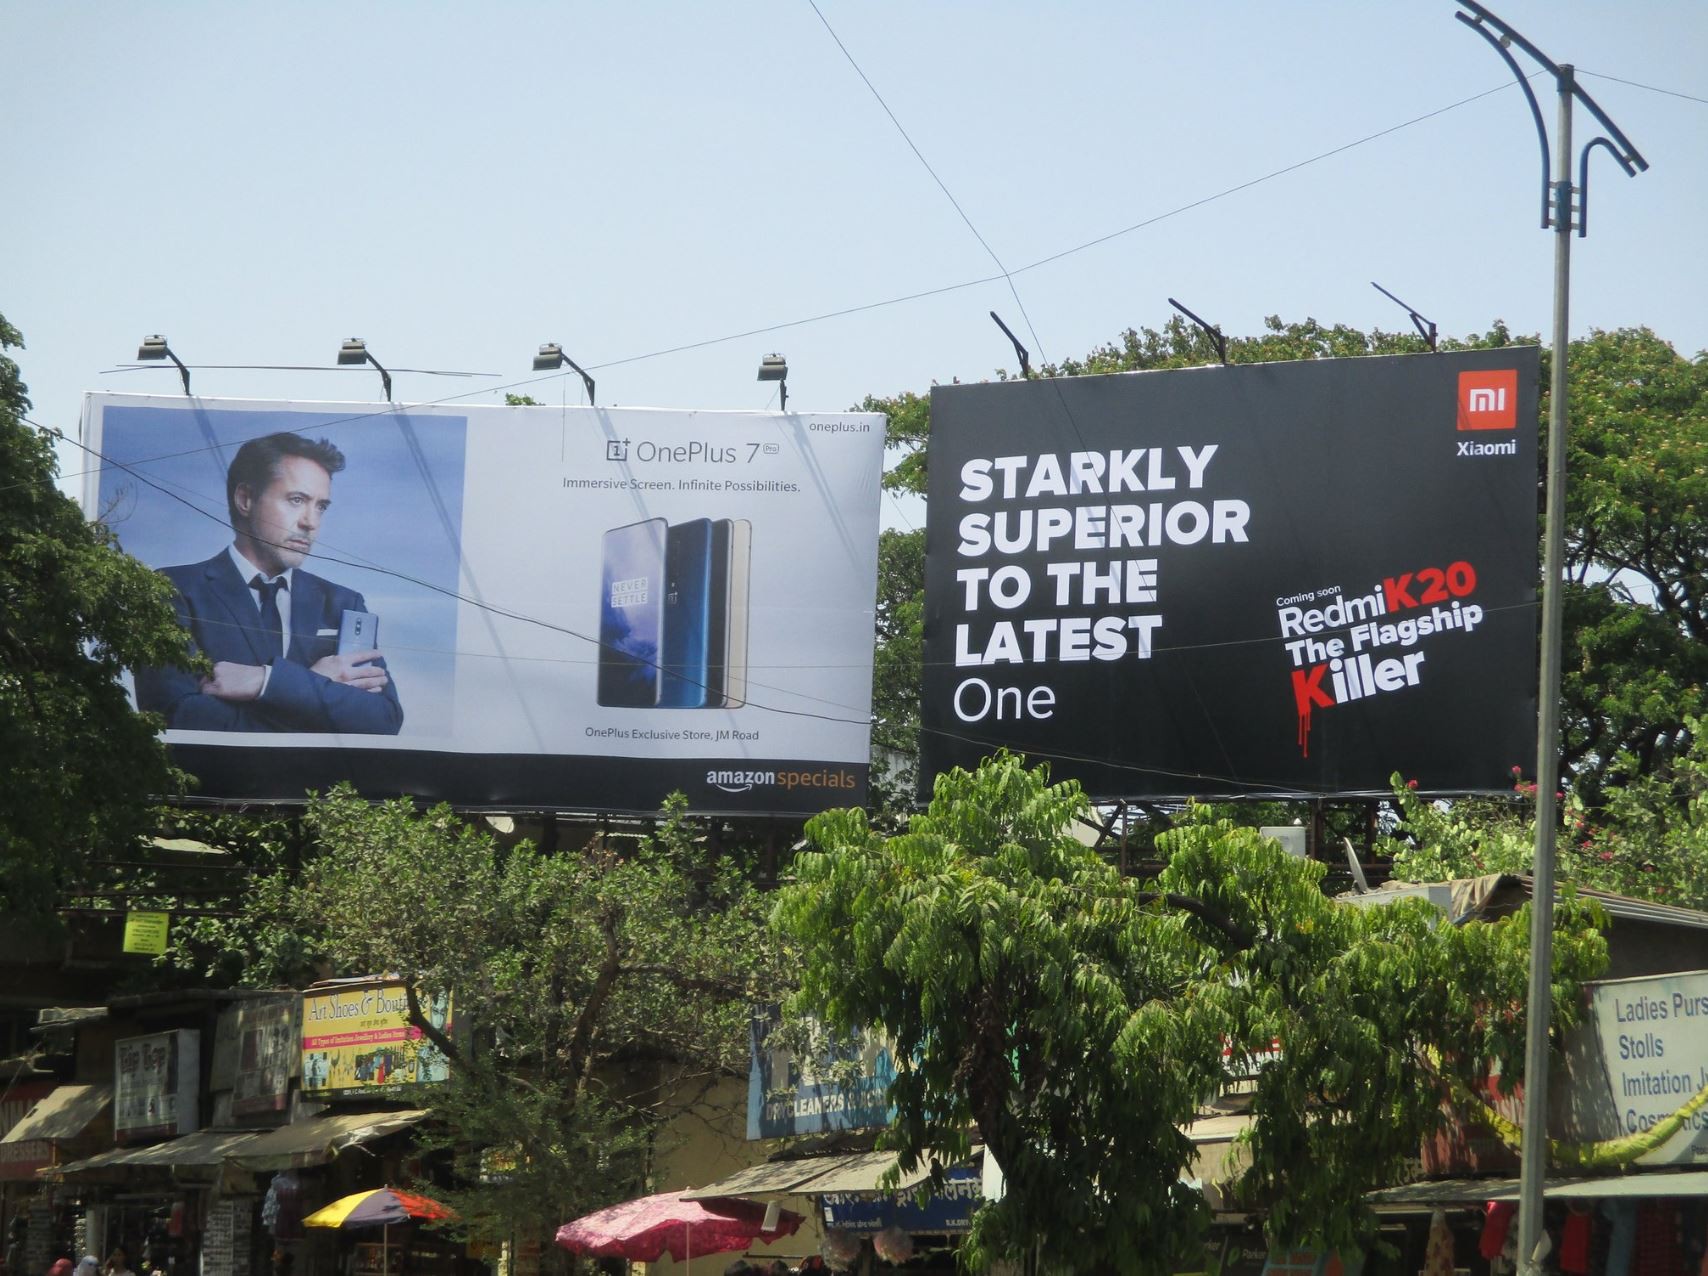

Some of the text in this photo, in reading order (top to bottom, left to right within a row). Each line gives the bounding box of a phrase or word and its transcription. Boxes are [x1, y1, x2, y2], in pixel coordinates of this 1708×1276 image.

[809, 422, 870, 434] oneplus.in
[637, 441, 736, 463] OnePlus
[746, 443, 760, 463] 7
[1457, 439, 1516, 456] Xiaomi
[562, 477, 801, 493] Immersive Screen. Infinite Possibilities.
[959, 445, 1219, 502] STARKLY
[957, 500, 1251, 557] SUPERIOR
[613, 579, 648, 593] NEVER
[956, 559, 1158, 611] TO THE
[1276, 584, 1341, 606] Coming soon
[611, 592, 648, 607] SETTLE
[955, 615, 1163, 667] LATEST
[1285, 601, 1483, 666] The Flagship
[1291, 650, 1425, 714] Killer
[954, 677, 1056, 722] One
[585, 726, 759, 742] OnePlus Exclusive Store, JM Road
[308, 998, 327, 1020] Art
[329, 994, 359, 1019] Shoes
[361, 989, 373, 1016] &
[1616, 996, 1668, 1023] Ladies
[1619, 1033, 1664, 1060] Stolls
[1622, 1069, 1691, 1097] Imitation
